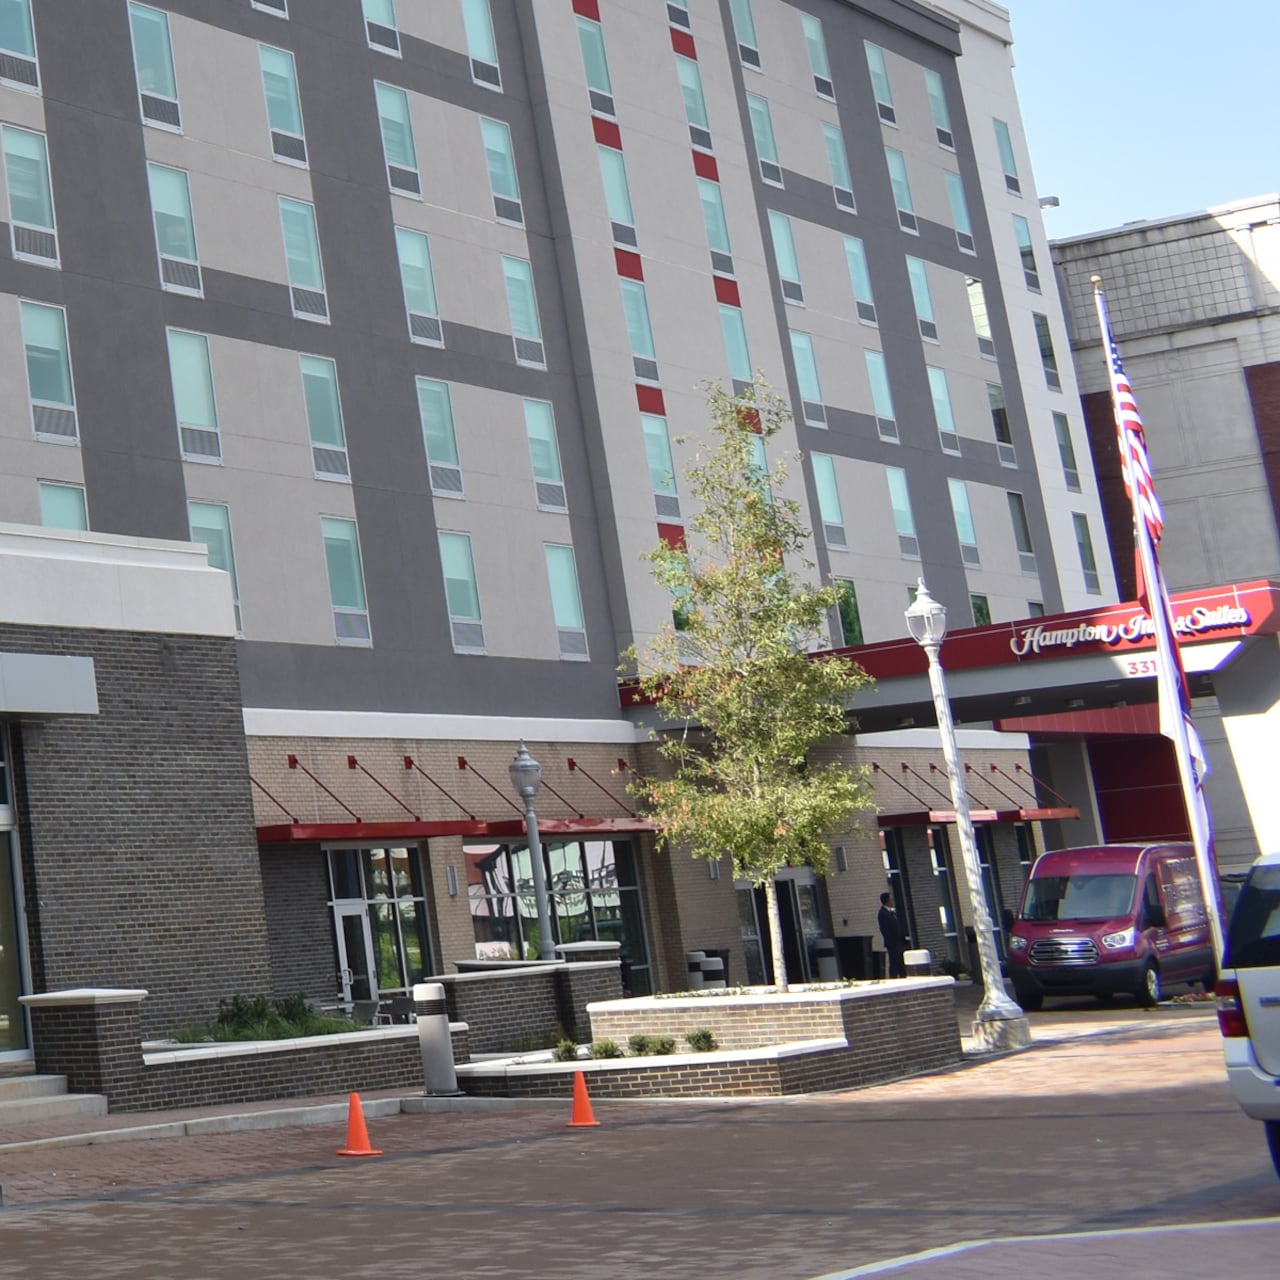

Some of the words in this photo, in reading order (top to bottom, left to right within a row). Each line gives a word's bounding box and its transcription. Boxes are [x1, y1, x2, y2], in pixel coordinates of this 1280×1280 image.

[1010, 623, 1118, 655] Hampton
[1119, 614, 1156, 639] In
[1186, 605, 1248, 629] Suites
